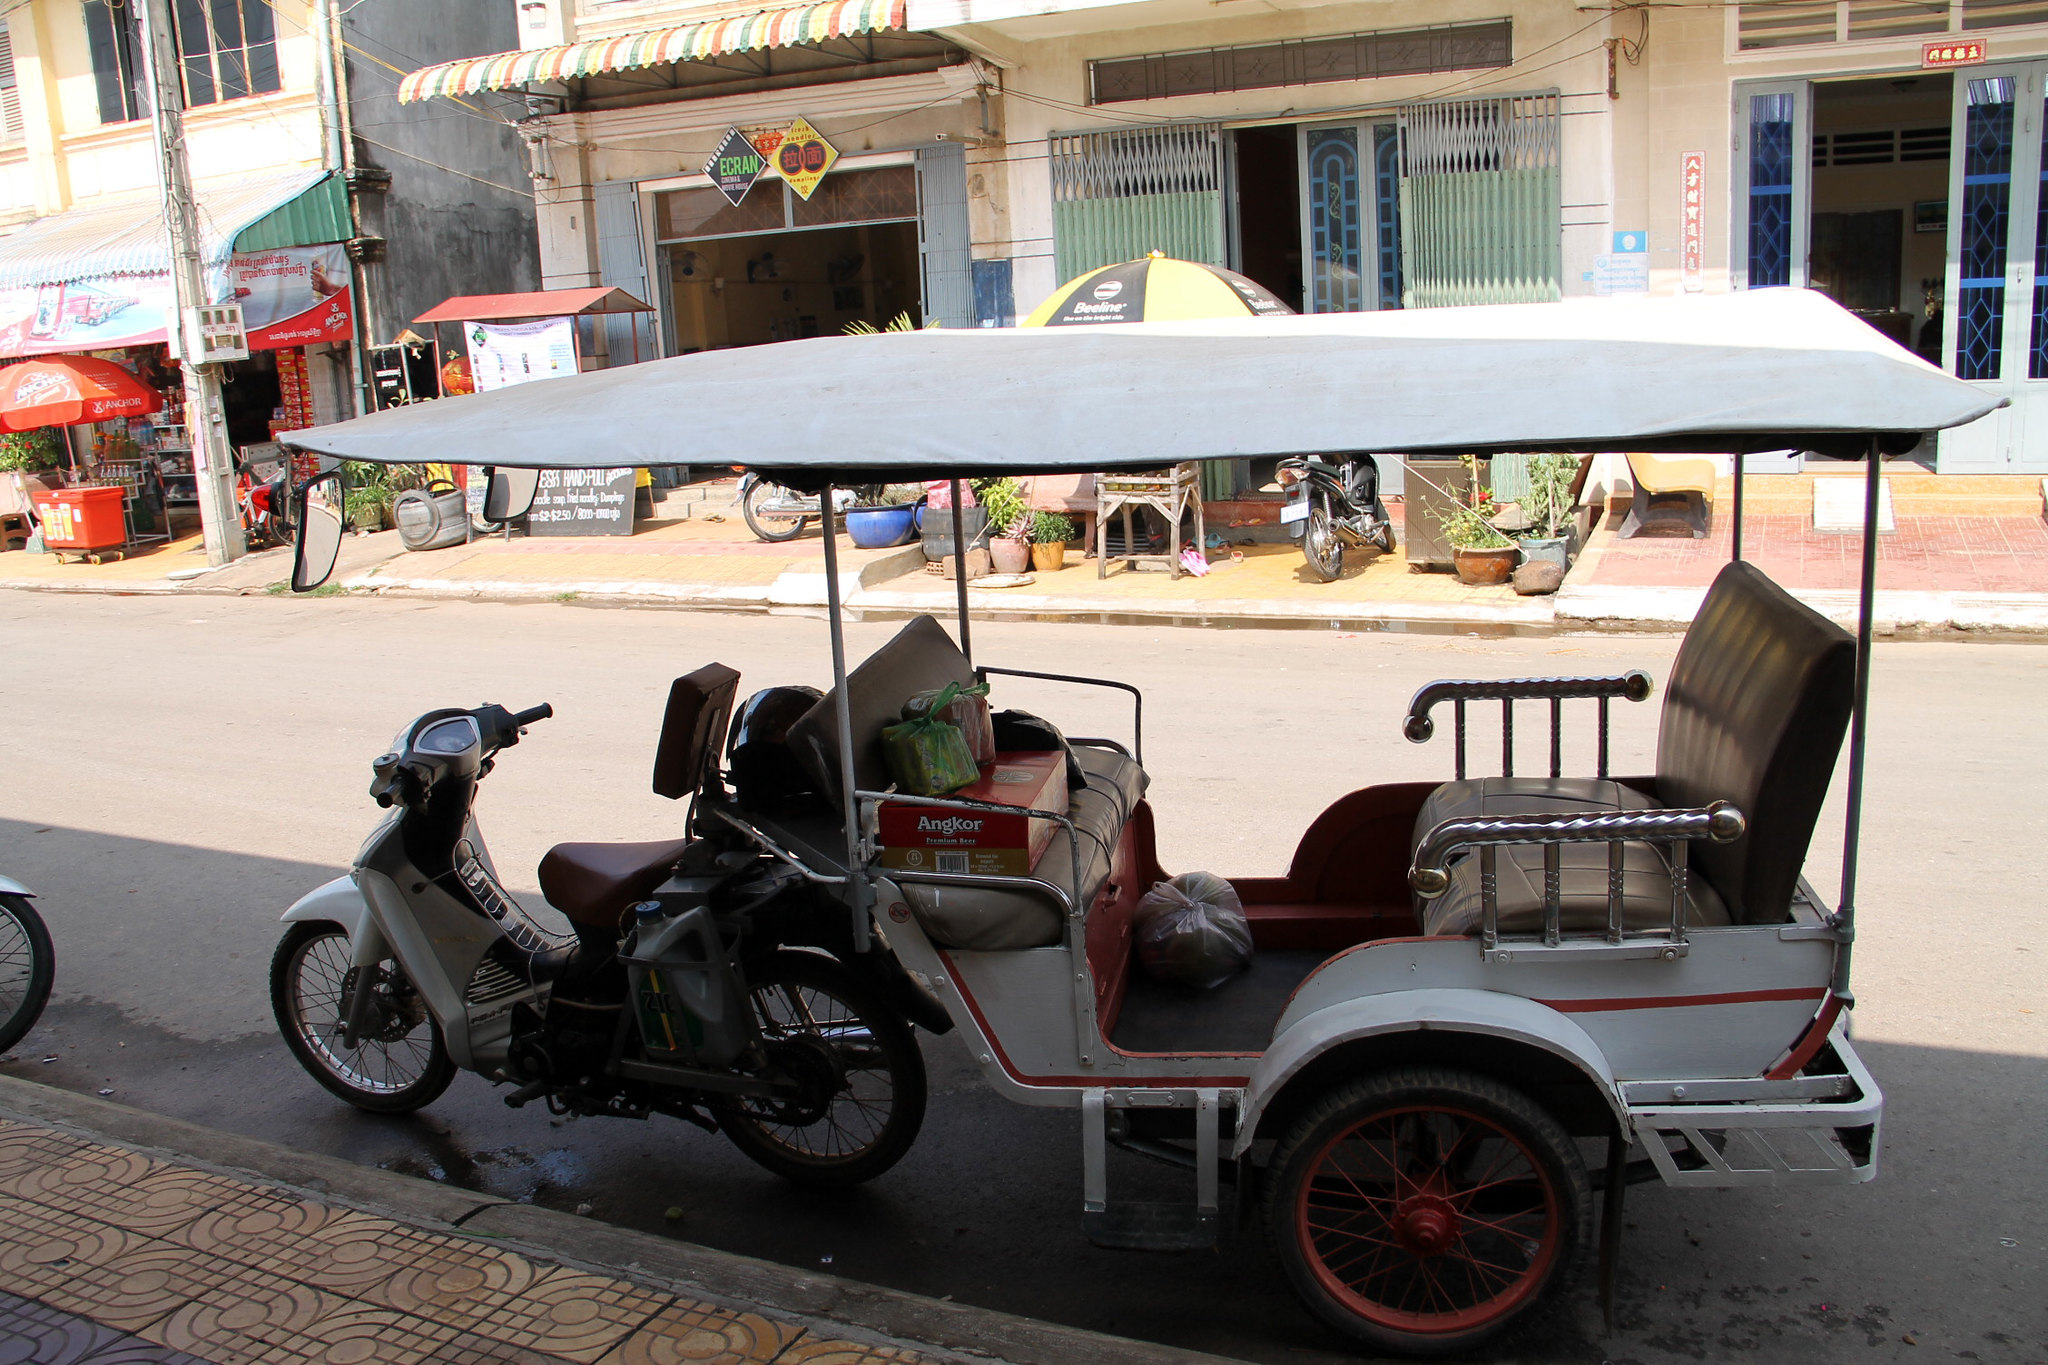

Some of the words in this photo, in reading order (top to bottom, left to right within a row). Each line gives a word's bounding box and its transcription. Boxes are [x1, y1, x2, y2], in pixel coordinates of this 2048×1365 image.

[720, 154, 759, 177] ECRAN
[1073, 301, 1123, 314] Beeline
[105, 397, 142, 409] ANCHOR
[917, 815, 984, 837] Angkor
